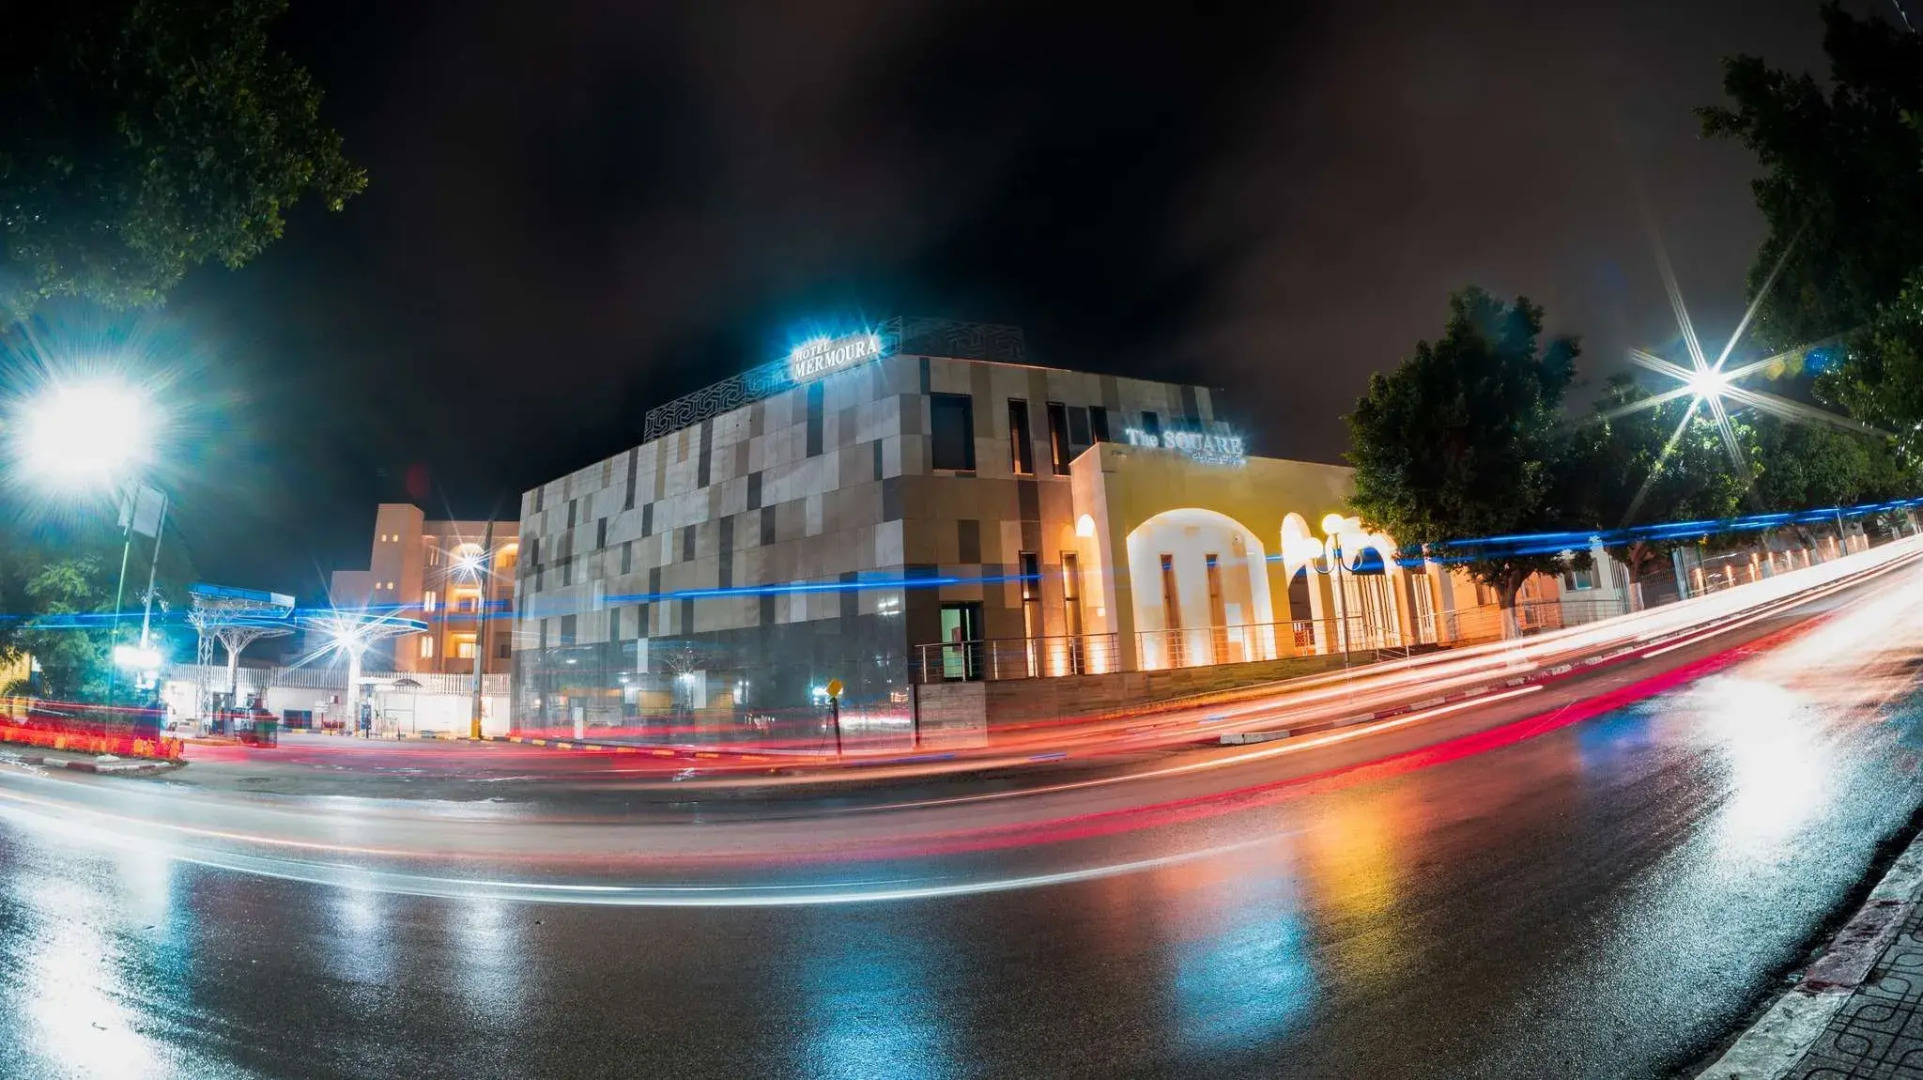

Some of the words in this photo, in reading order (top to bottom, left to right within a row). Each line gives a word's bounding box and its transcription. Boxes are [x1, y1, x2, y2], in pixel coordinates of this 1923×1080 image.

[794, 337, 877, 378] MERMOURA
[795, 341, 830, 361] HOTEL
[1125, 427, 1159, 448] The
[1162, 430, 1244, 455] SQUARE
